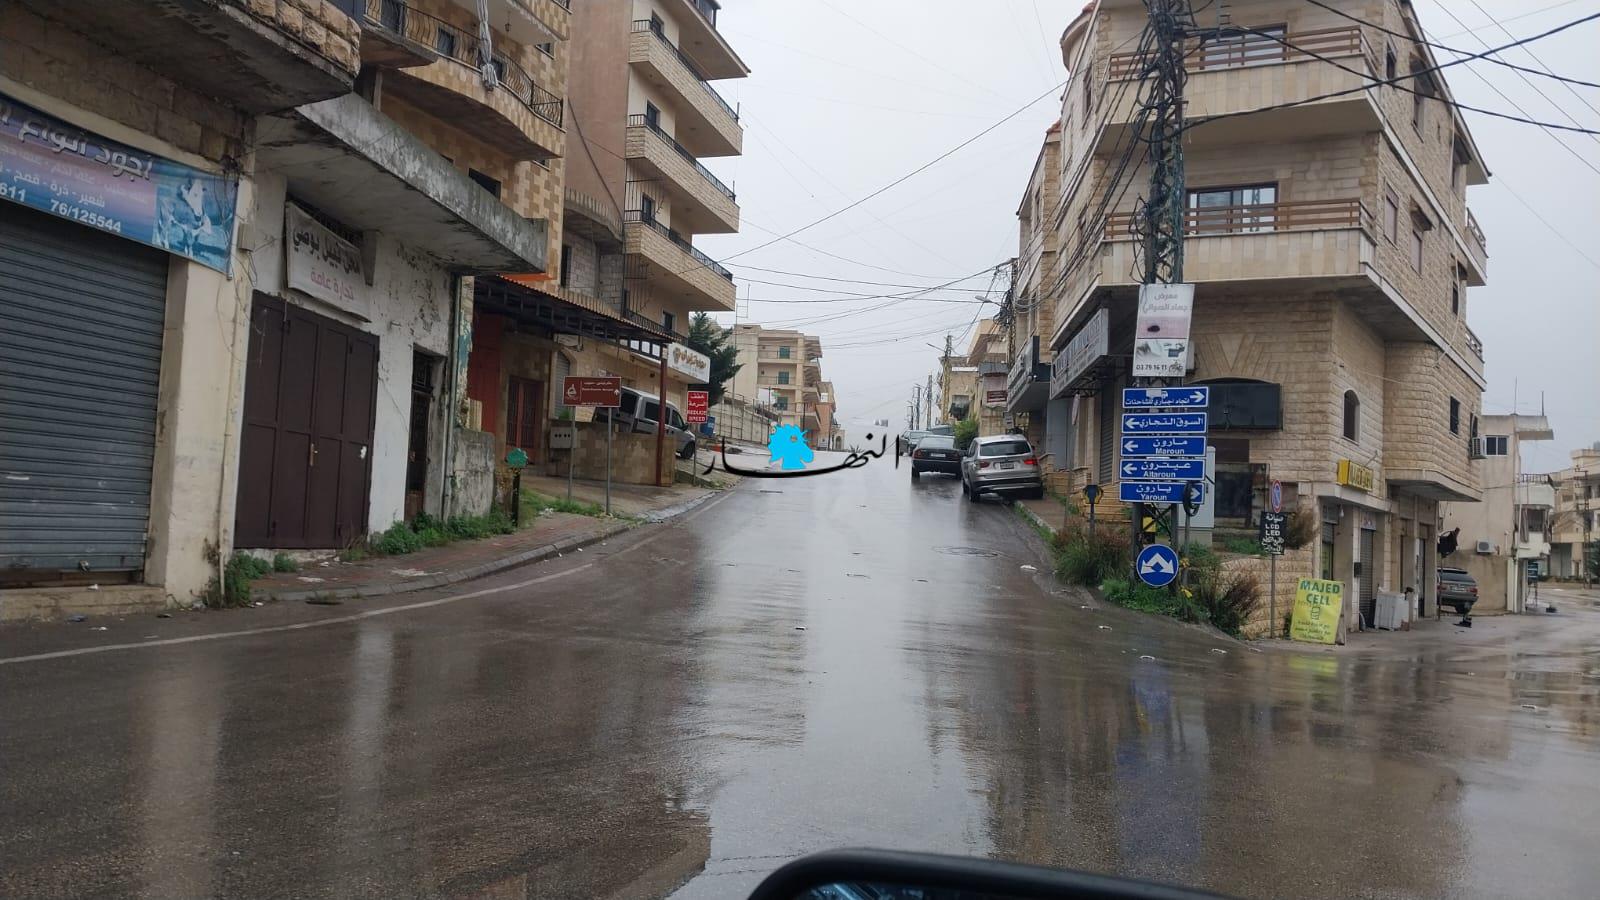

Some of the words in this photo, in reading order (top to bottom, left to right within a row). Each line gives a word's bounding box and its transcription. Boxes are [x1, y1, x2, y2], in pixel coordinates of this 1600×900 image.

[50, 199, 121, 233] 76/125544
[310, 266, 332, 291] عامة
[1139, 417, 1176, 428] التجاري
[1176, 417, 1203, 427] السوق
[1152, 438, 1188, 448] مارون
[1140, 461, 1192, 471] عيترون
[1136, 484, 1172, 493] يارون
[1140, 493, 1167, 501] Yaroun
[1300, 580, 1340, 594] MAJED
[1306, 593, 1330, 606] CELL
